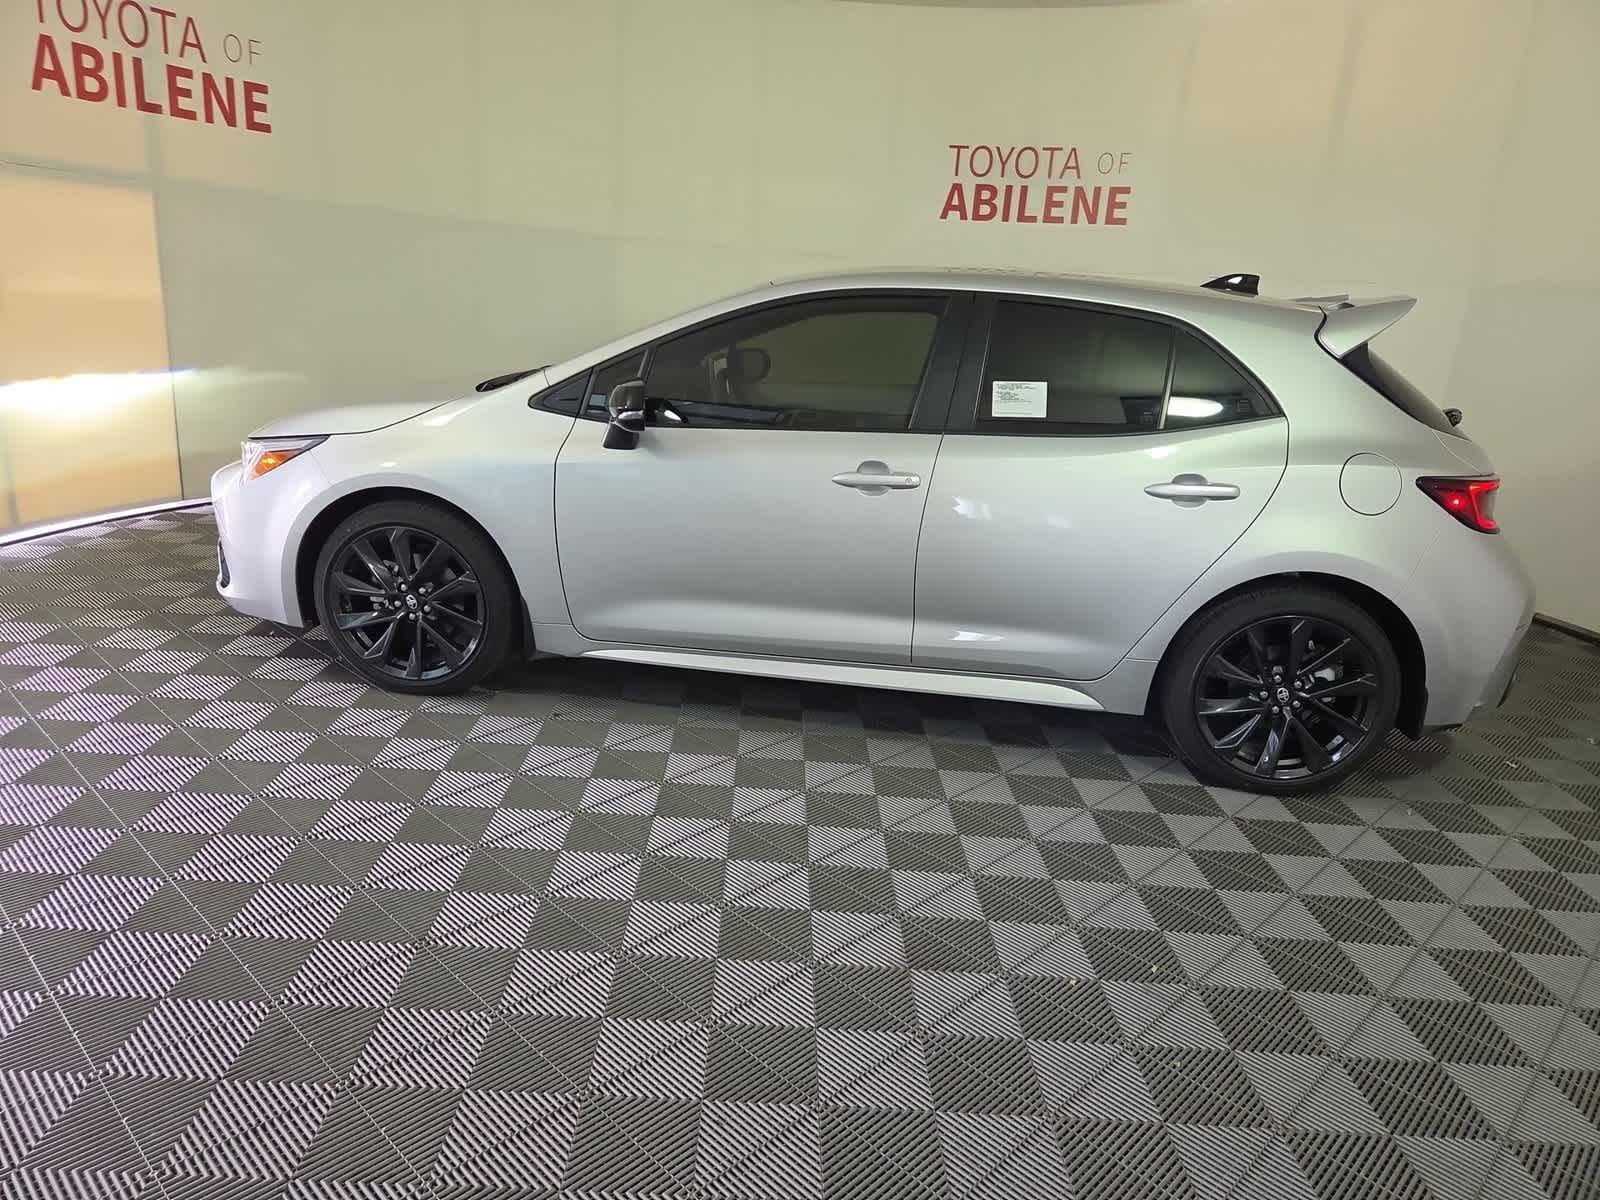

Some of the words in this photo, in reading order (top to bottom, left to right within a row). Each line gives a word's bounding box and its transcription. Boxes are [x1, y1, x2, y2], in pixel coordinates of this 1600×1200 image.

[223, 33, 263, 65] OF
[32, 33, 272, 133] ABILENE
[949, 145, 1081, 179] TOYOTA
[1097, 152, 1132, 175] OF
[939, 183, 1132, 226] ABILENE
